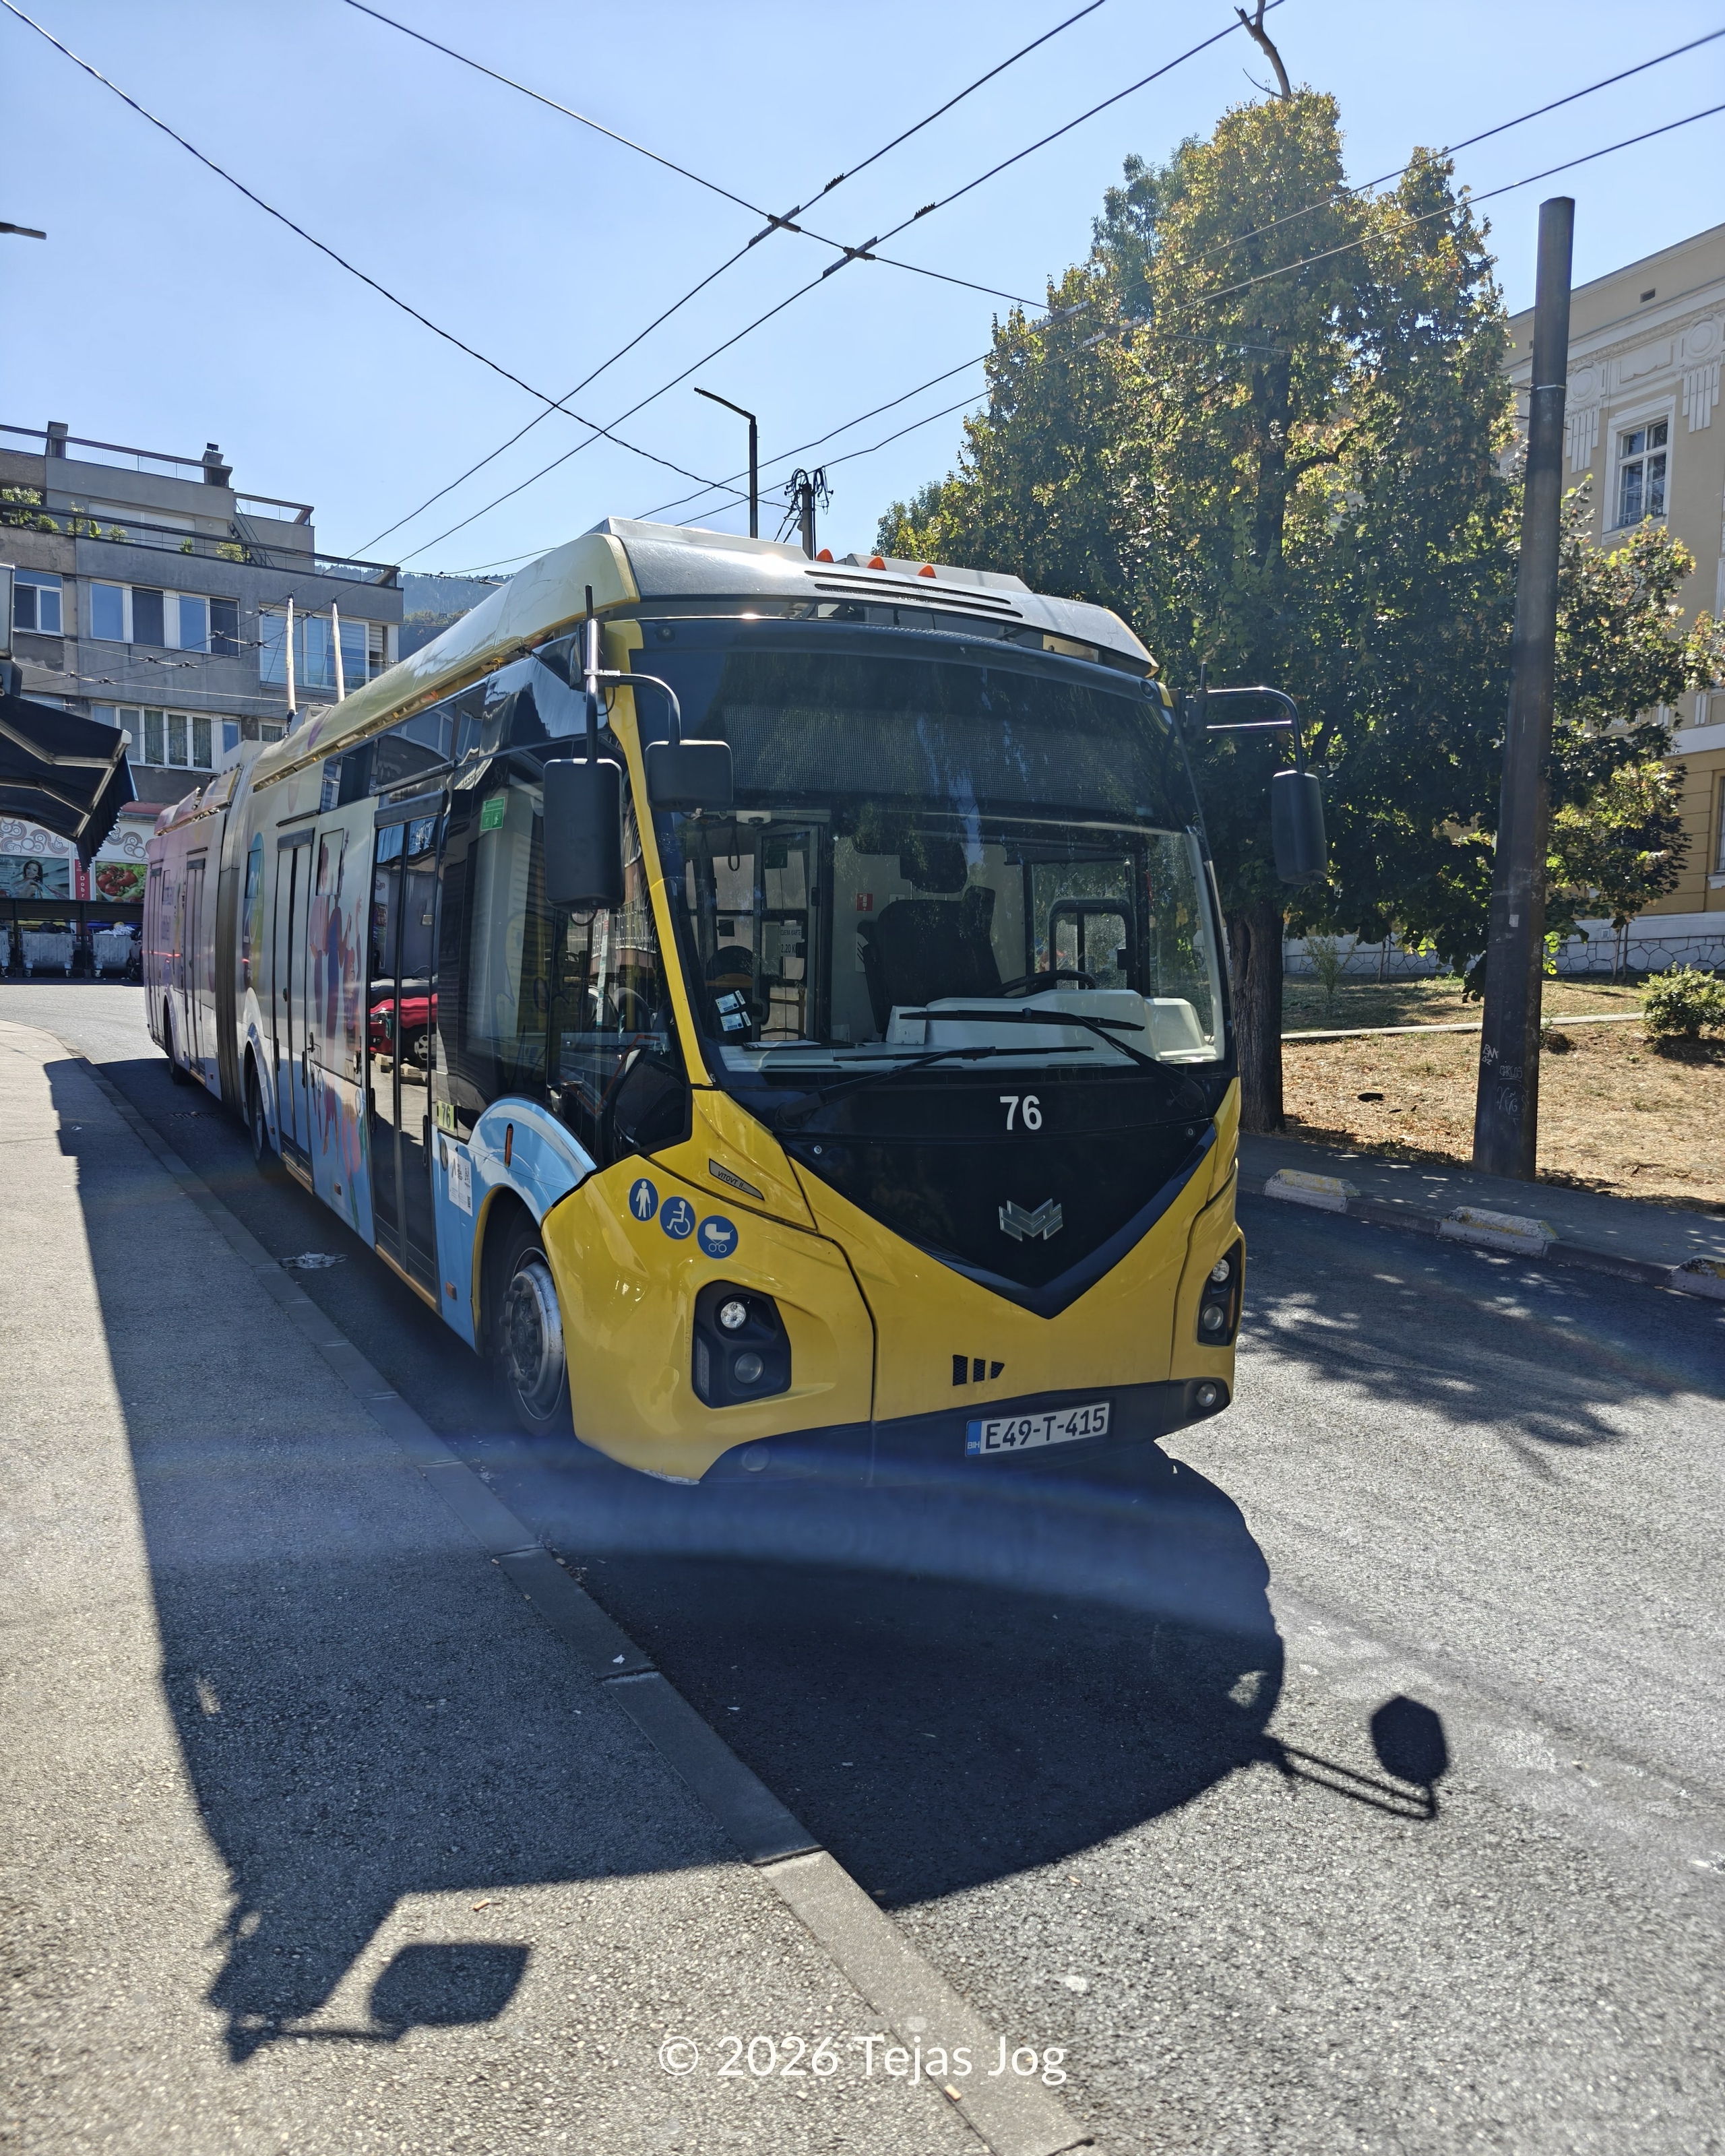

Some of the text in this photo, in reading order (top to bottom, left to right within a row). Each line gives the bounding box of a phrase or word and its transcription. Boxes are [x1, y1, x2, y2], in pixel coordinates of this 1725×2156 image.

[781, 943, 791, 953] 2.20
[441, 1102, 451, 1129] 76
[999, 1095, 1042, 1131] 76
[718, 1170, 739, 1185] VITOVT
[967, 1406, 1106, 1449] BIH E49-T-415
